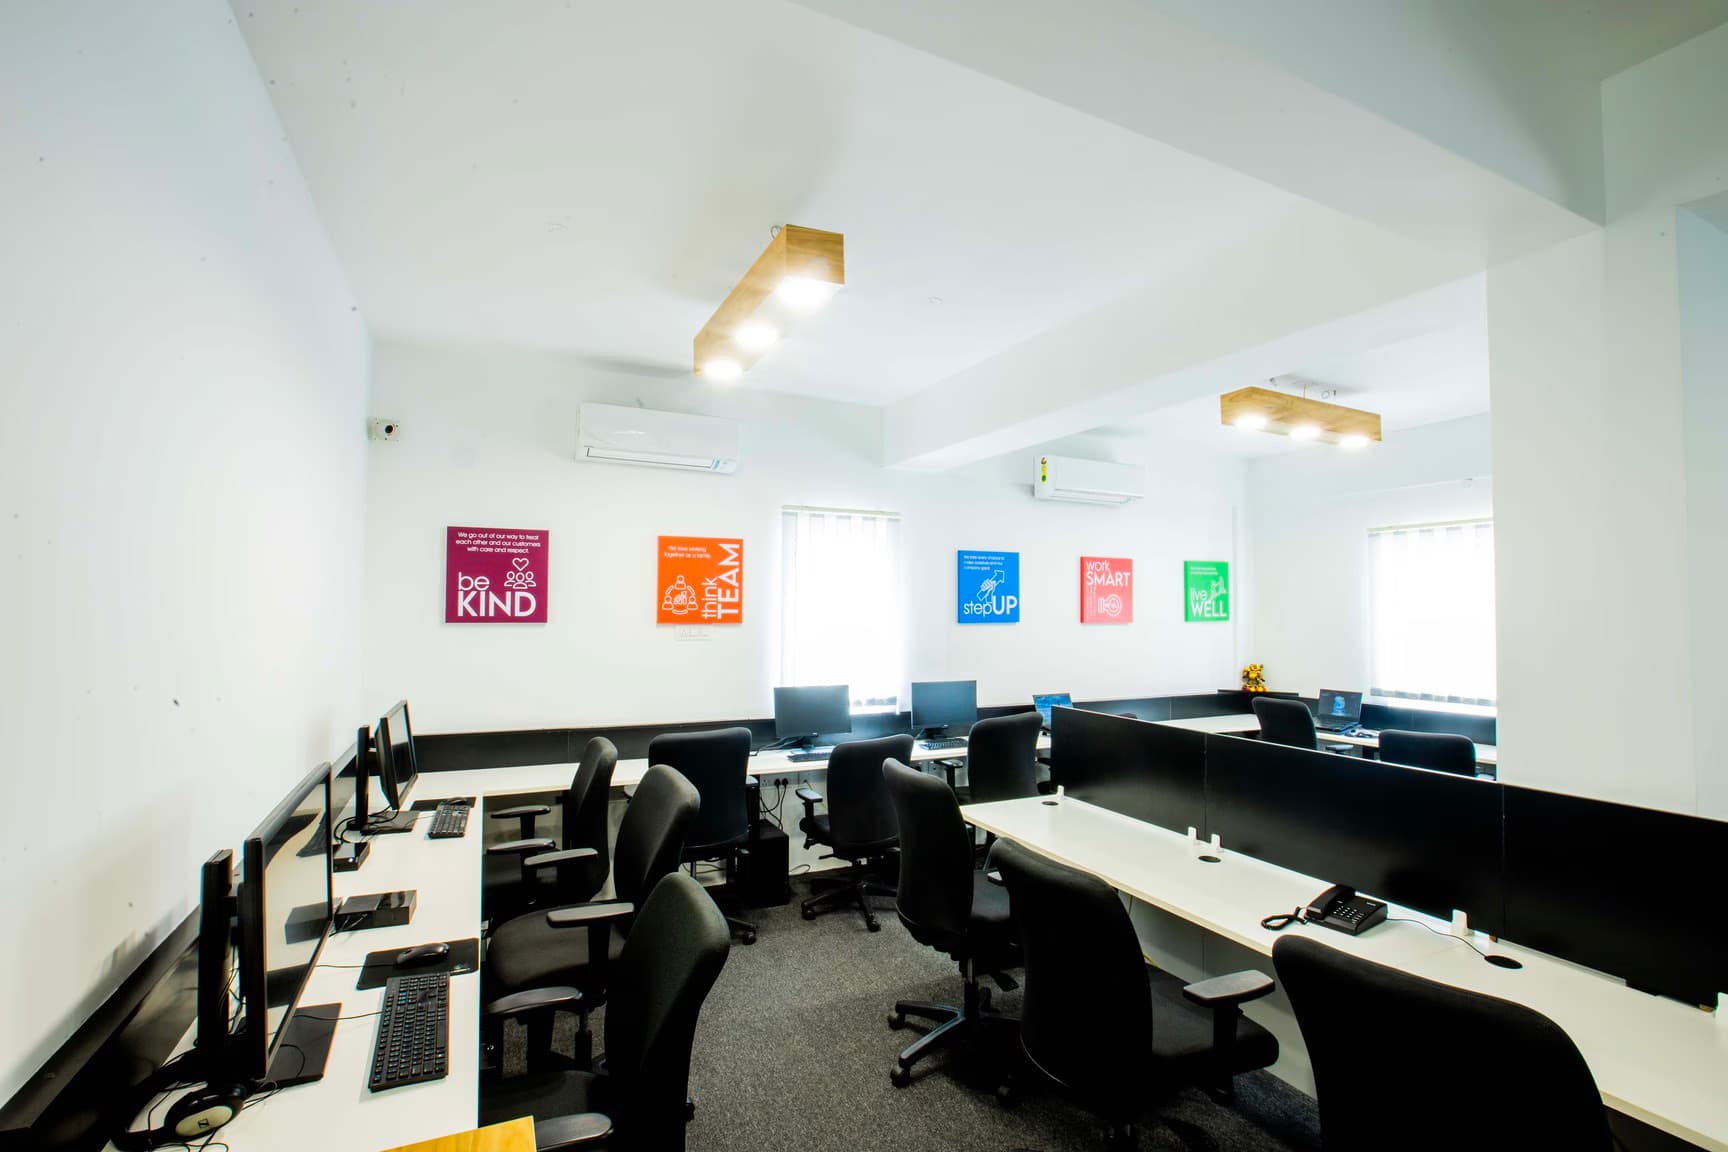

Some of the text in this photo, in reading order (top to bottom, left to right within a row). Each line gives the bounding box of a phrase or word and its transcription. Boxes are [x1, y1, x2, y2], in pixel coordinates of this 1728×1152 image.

[1086, 560, 1110, 571] work
[458, 571, 490, 591] be
[717, 543, 740, 620] TEAM
[1086, 571, 1131, 587] SMART
[701, 577, 718, 620] think
[1190, 588, 1208, 600] live
[457, 590, 537, 617] KIND
[1191, 600, 1228, 617] WELL
